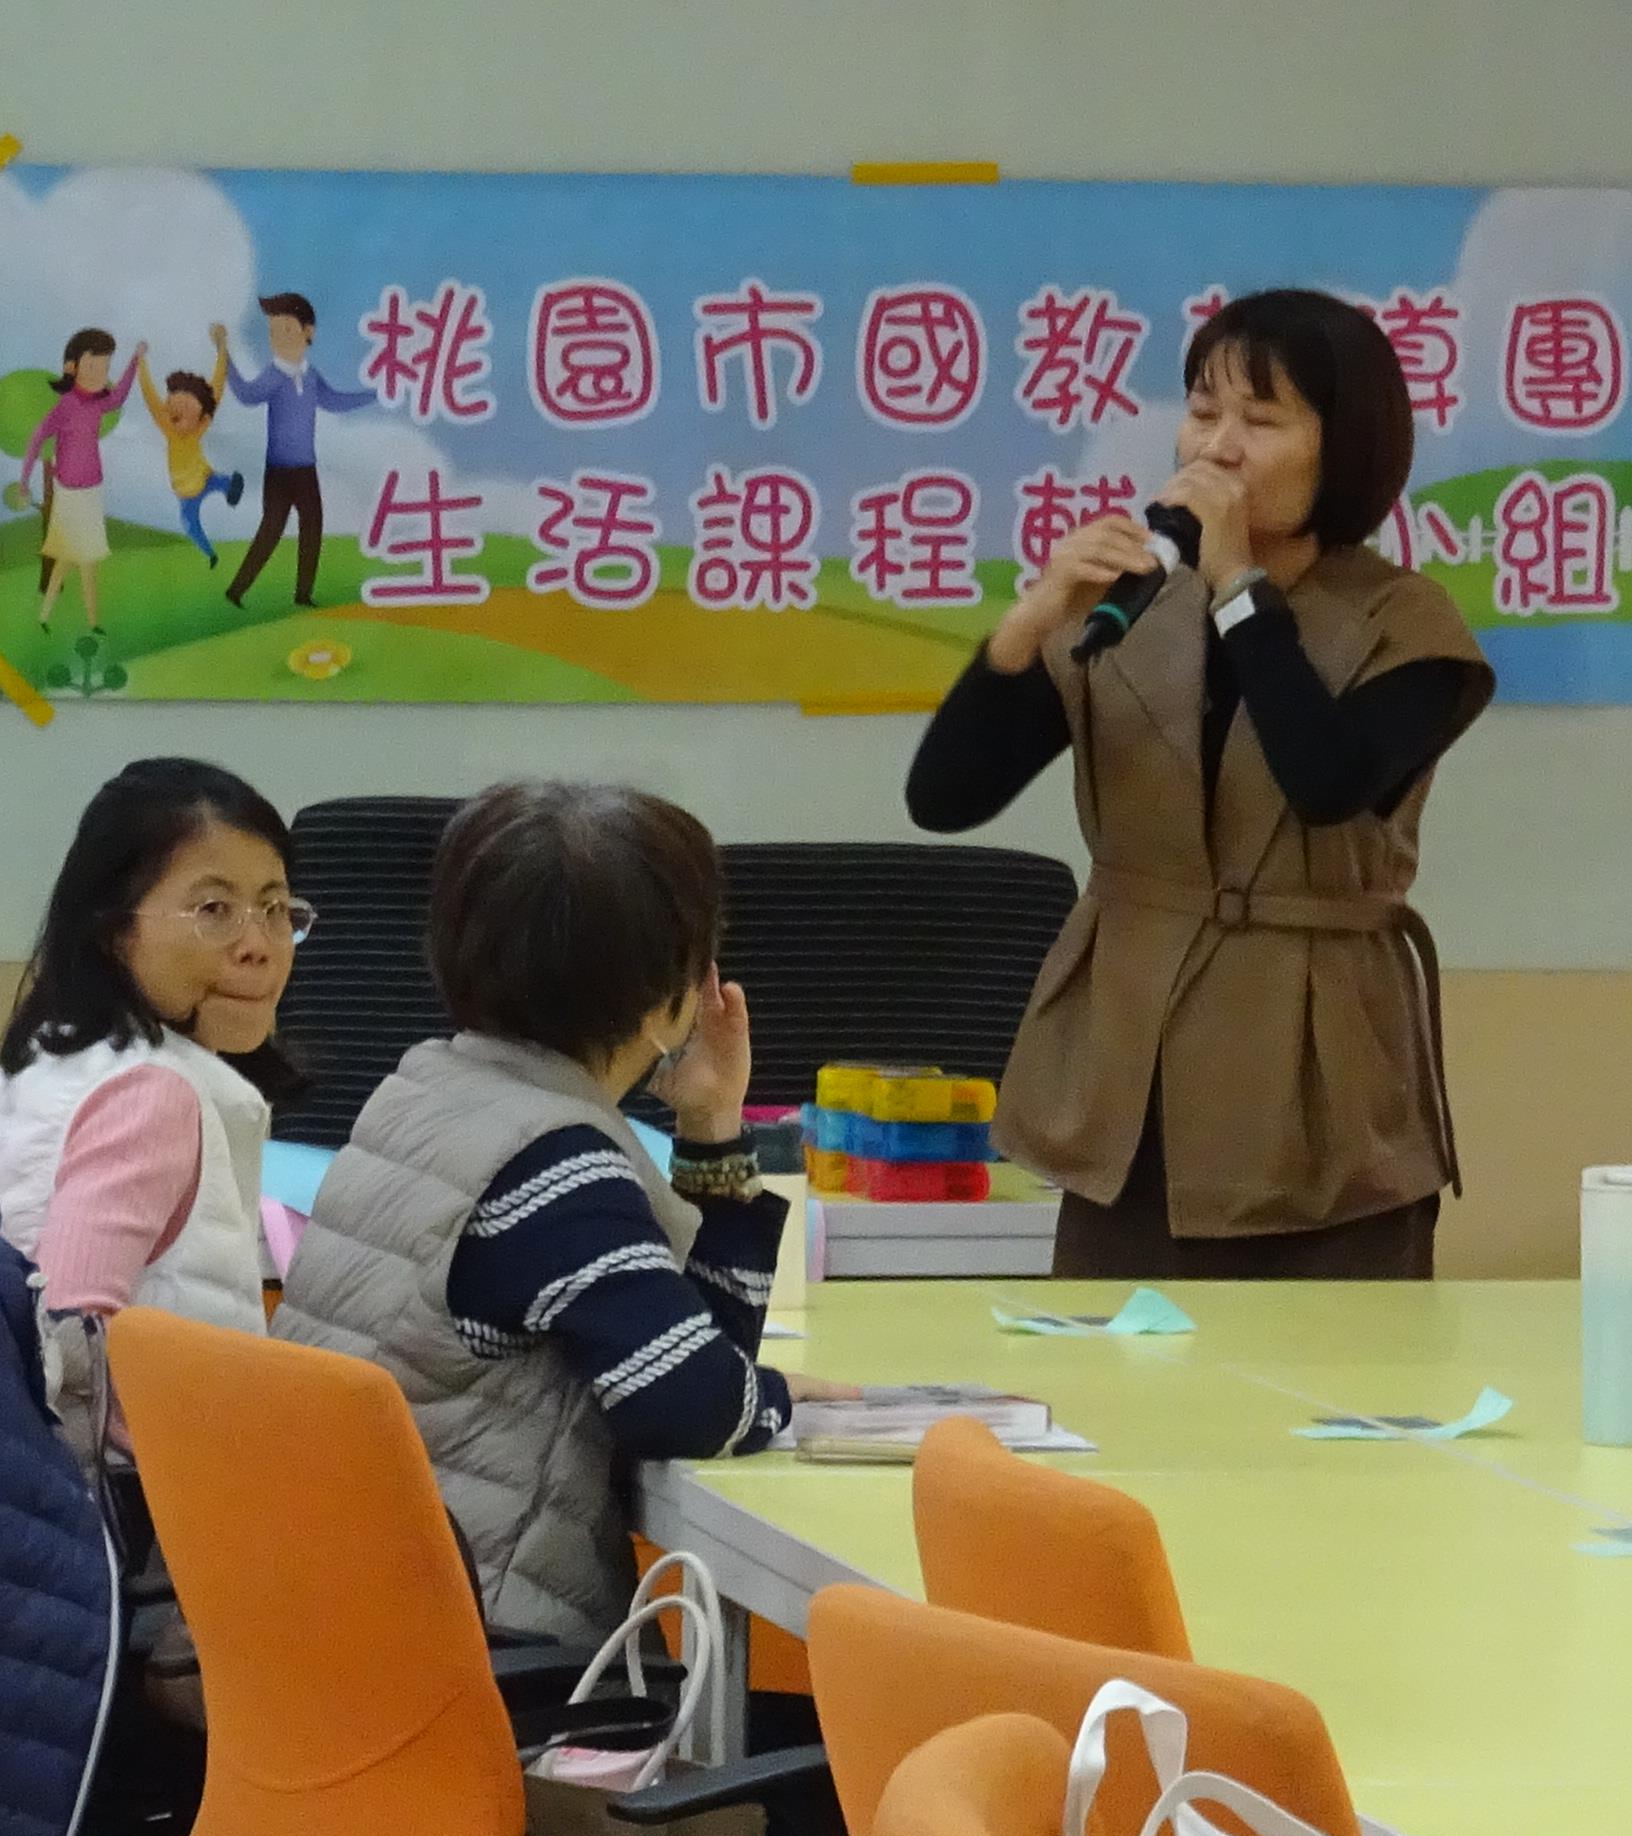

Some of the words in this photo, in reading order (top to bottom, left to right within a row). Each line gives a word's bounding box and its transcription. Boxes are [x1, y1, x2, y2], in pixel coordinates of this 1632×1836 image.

[366, 283, 1623, 429] 桃園市國教導團
